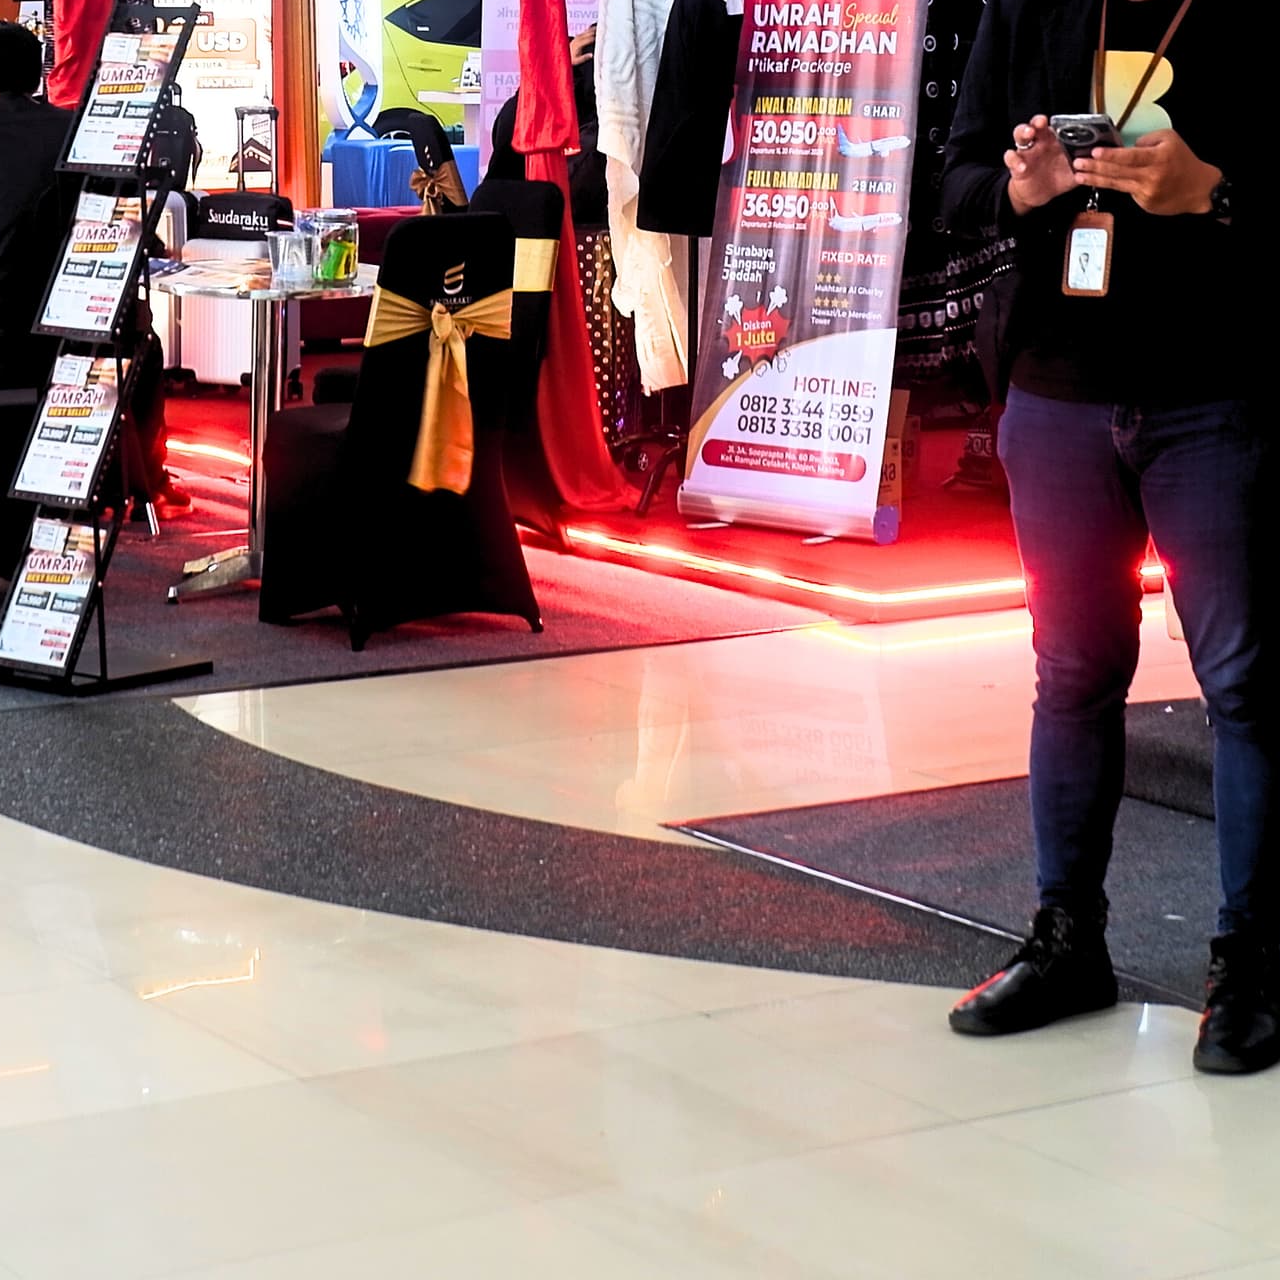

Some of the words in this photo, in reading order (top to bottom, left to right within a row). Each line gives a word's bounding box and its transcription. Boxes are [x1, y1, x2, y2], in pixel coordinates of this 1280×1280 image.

[753, 3, 841, 27] UMRAH
[843, 2, 899, 32] Special
[197, 31, 248, 53] USD
[750, 30, 897, 55] RAMADHAN
[101, 68, 156, 82] UMRAH
[791, 58, 852, 77] Package
[755, 97, 784, 114] AWAL
[786, 97, 852, 116] RAMADHAN
[863, 106, 871, 116] 9
[872, 106, 901, 118] HARI
[746, 170, 771, 187] FULL
[772, 170, 838, 190] RAMADHAN
[869, 181, 897, 194] HARI
[208, 208, 269, 226] Saudaraku
[75, 227, 128, 240] UMRAH
[725, 243, 774, 259] Surabaya
[821, 251, 854, 263] FIXED
[856, 254, 887, 266] RATE
[724, 257, 776, 274] Langsung
[722, 269, 763, 283] Jeddah
[743, 320, 772, 331] Diskon
[744, 329, 776, 346] Juta
[794, 376, 877, 399] HOTLINE:
[51, 392, 104, 404] UMRAH
[740, 394, 777, 414] 0812
[738, 415, 776, 435] 0813
[29, 557, 86, 572] UMRAH
